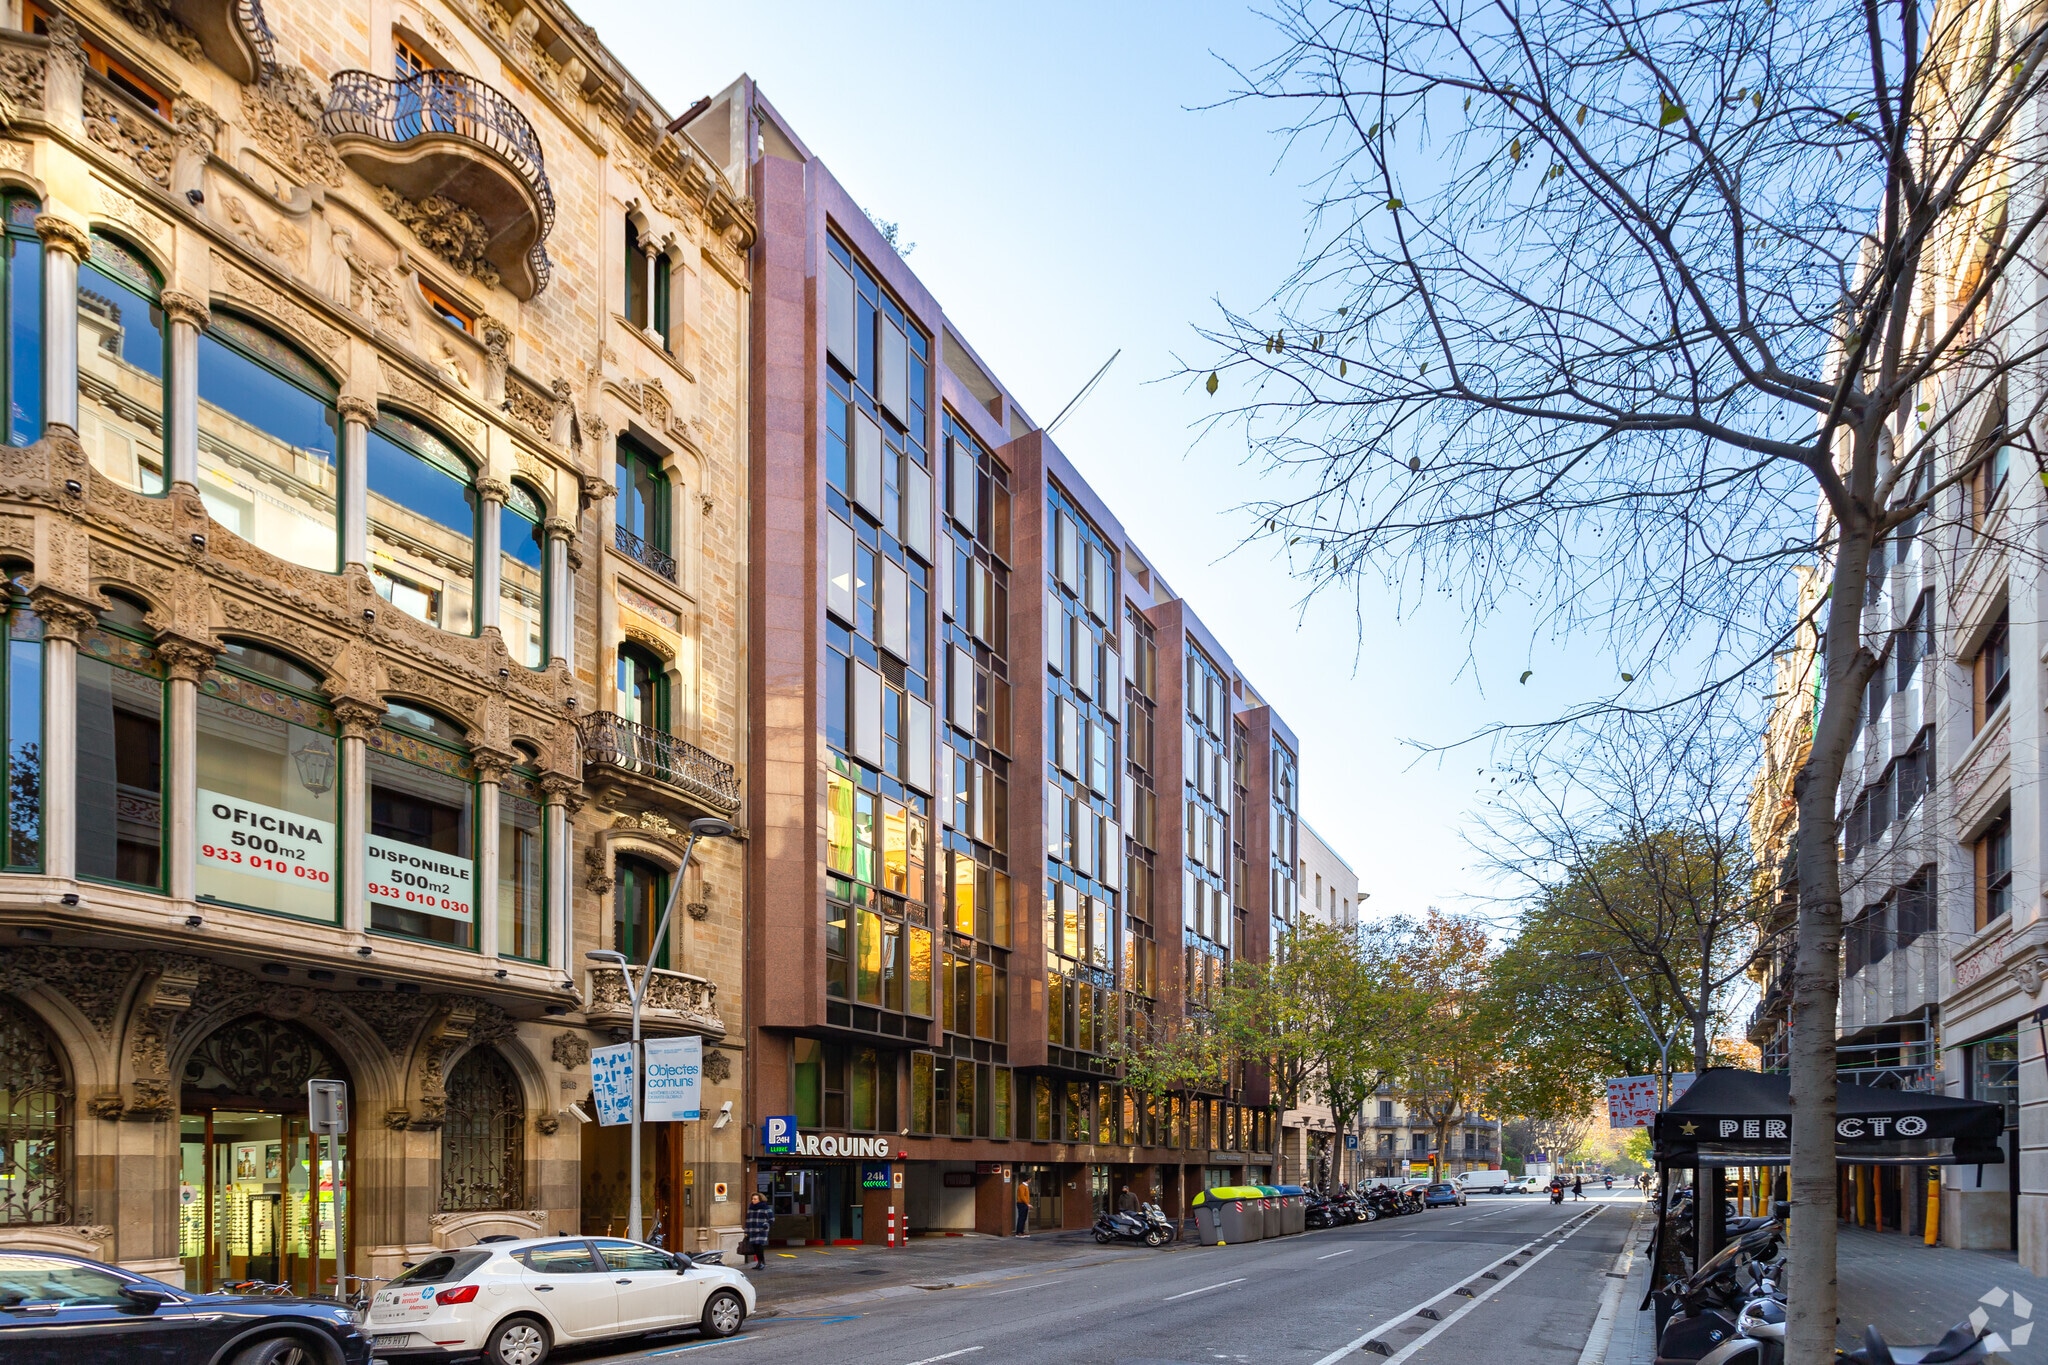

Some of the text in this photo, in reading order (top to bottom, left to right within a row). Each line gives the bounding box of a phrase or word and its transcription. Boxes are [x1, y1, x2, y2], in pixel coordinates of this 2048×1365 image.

[212, 803, 323, 844] OFICINA
[231, 830, 306, 861] 500m2
[201, 844, 330, 883] 933 010 030
[368, 846, 470, 880] DISPONIBLE
[391, 869, 450, 895] 500m2
[368, 882, 469, 914] 933 010 030
[648, 1064, 699, 1078] Objectes
[648, 1077, 694, 1088] comuns
[768, 1118, 787, 1144] P
[776, 1136, 790, 1144] 24H
[1719, 1115, 1927, 1139] PERCTO
[1348, 1137, 1356, 1148] P
[866, 1171, 885, 1181] 24h
